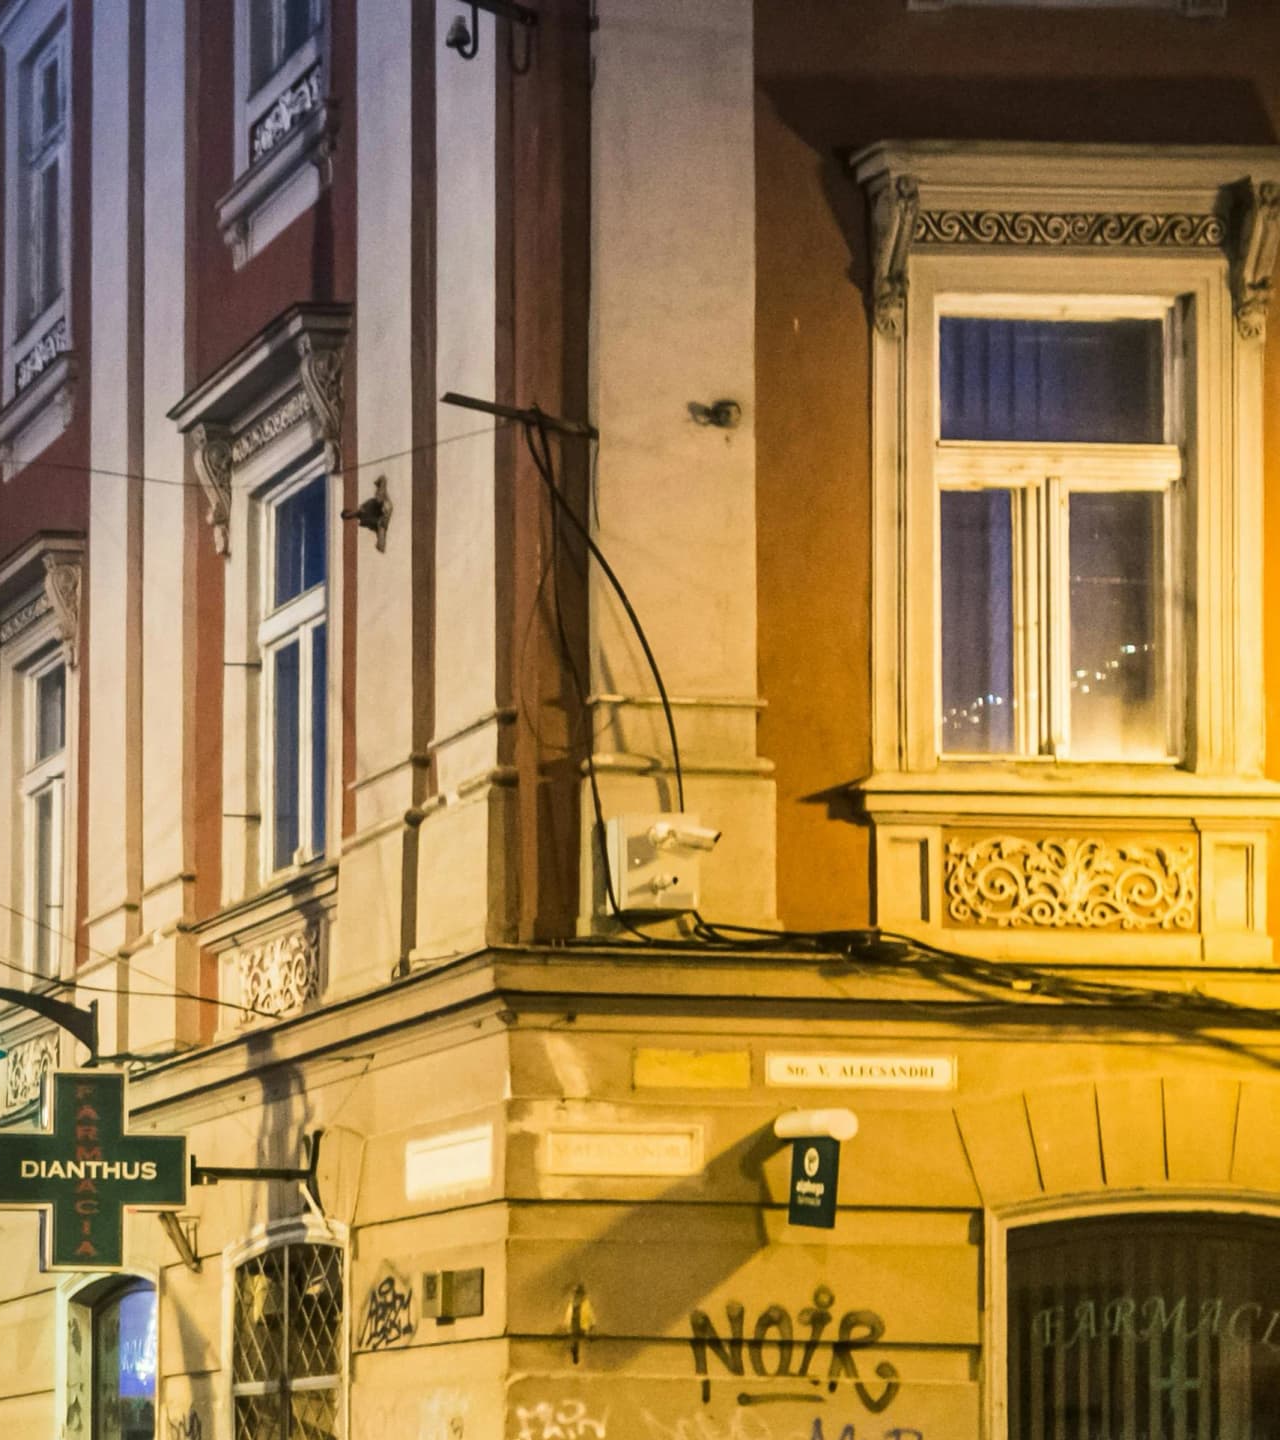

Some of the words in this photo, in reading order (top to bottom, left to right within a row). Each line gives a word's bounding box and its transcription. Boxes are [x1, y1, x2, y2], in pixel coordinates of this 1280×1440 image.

[839, 1063, 936, 1079] ALECSANDRI
[20, 1159, 158, 1181] DIANTHUS
[73, 1083, 103, 1256] FARMACIA
